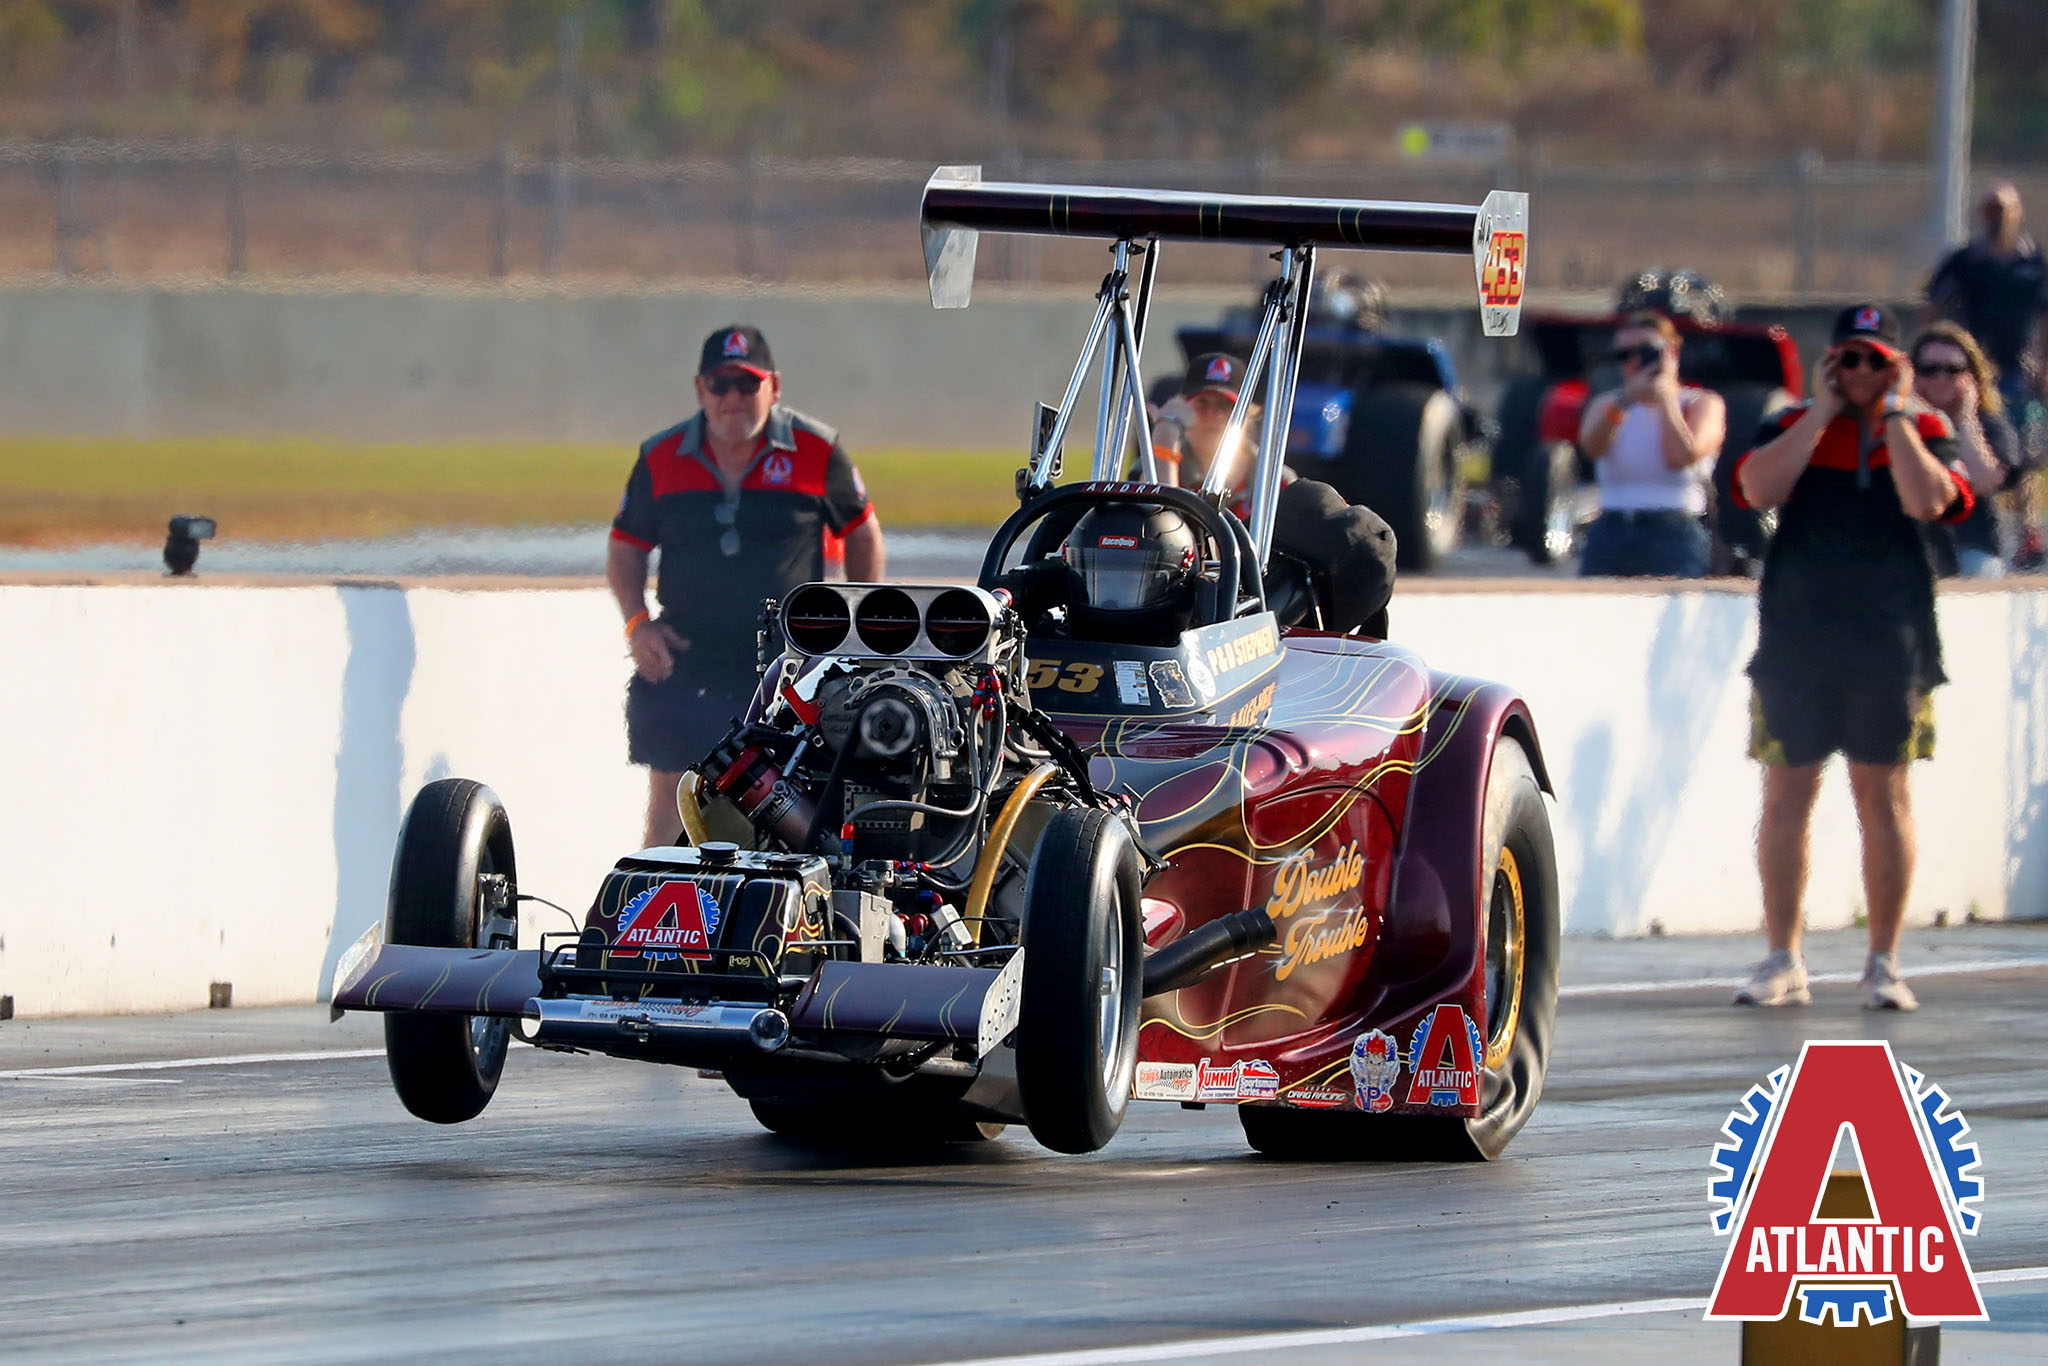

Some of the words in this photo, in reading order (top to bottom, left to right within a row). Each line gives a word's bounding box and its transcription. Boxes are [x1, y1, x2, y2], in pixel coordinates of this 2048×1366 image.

[1482, 232, 1525, 304] 453
[1086, 483, 1162, 494] ANDRA
[1011, 658, 1105, 693] 53
[1266, 839, 1366, 919] Double
[627, 928, 701, 944] ATLANTIC
[1275, 905, 1369, 981] Trouble
[1198, 1062, 1238, 1091] SUMMIT
[1417, 1069, 1473, 1089] ATLANTIC
